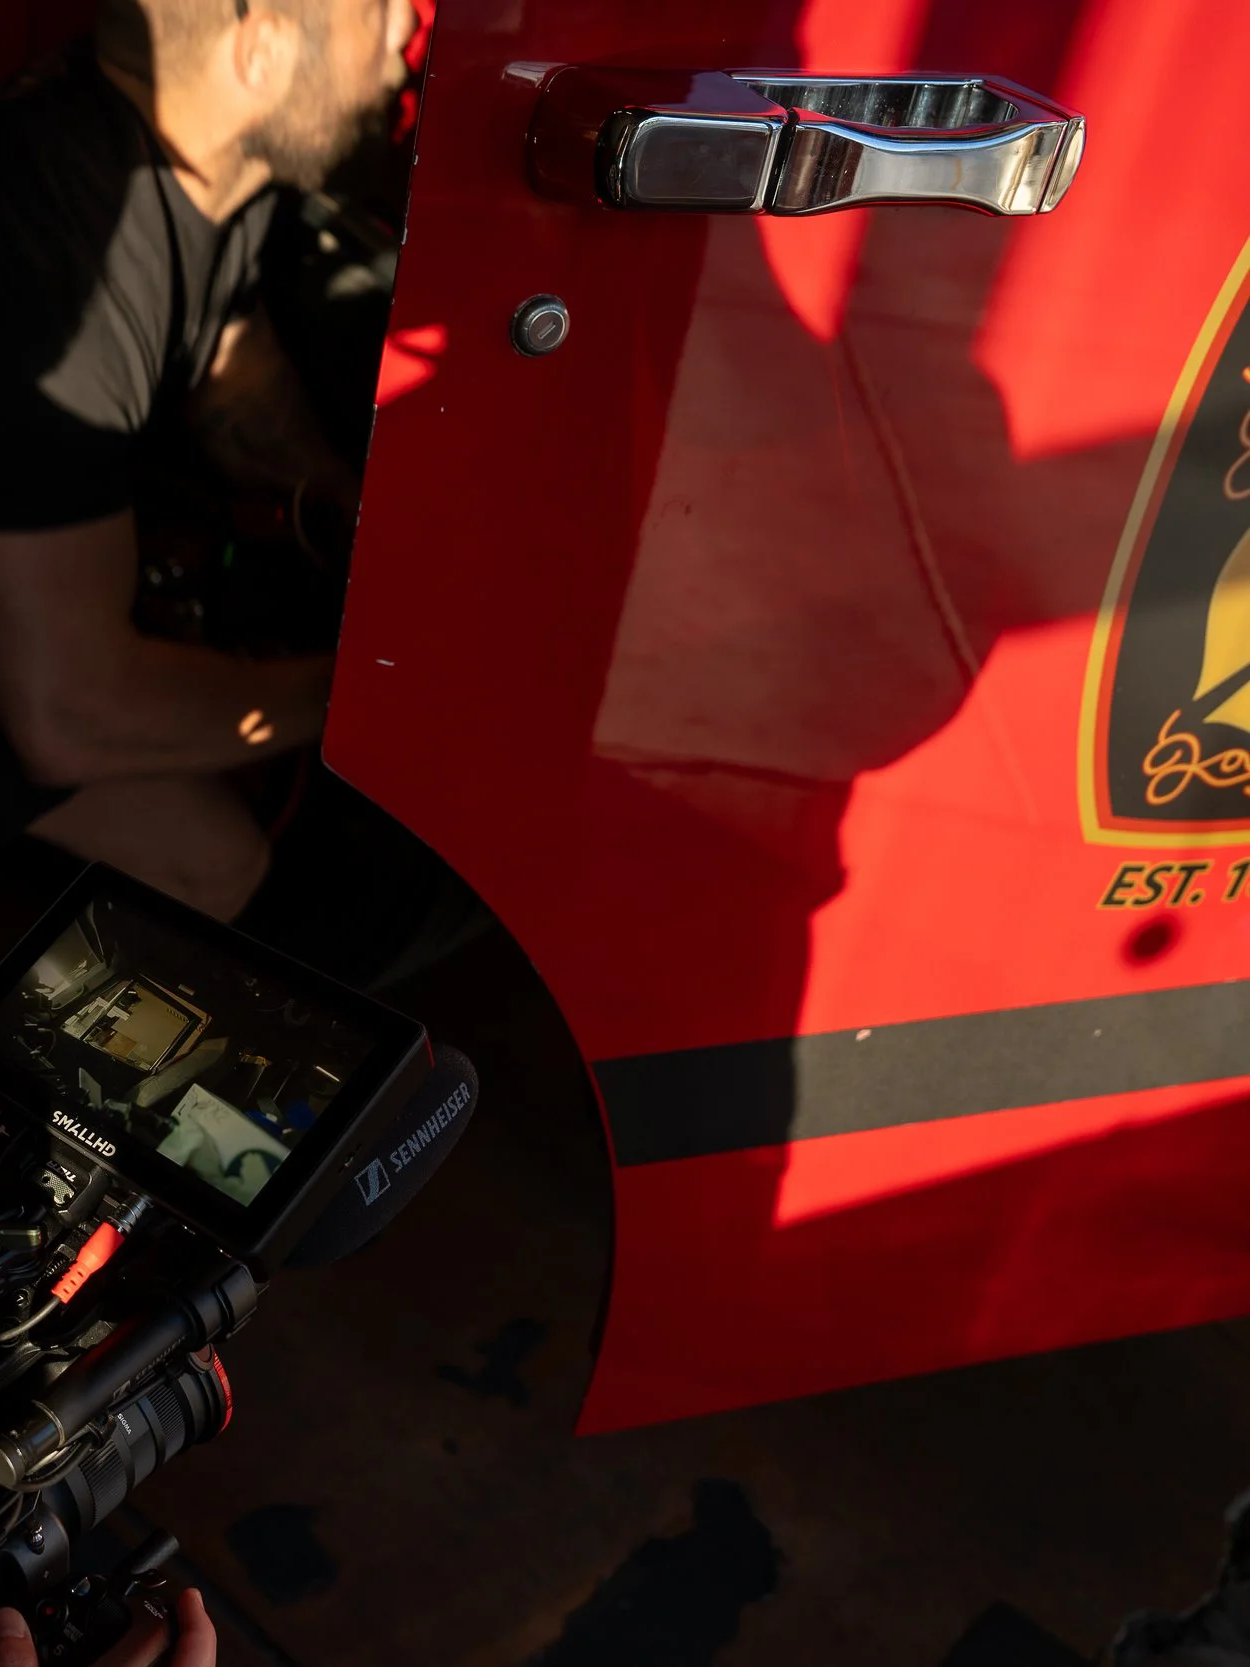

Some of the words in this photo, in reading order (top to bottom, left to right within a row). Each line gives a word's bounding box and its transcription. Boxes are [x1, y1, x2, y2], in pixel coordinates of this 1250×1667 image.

[1098, 859, 1213, 908] EST.
[1222, 857, 1250, 904] 1
[52, 1110, 117, 1157] SMALLHD
[389, 1081, 471, 1173] SENNHEISER
[117, 1413, 132, 1435] SIGMA
